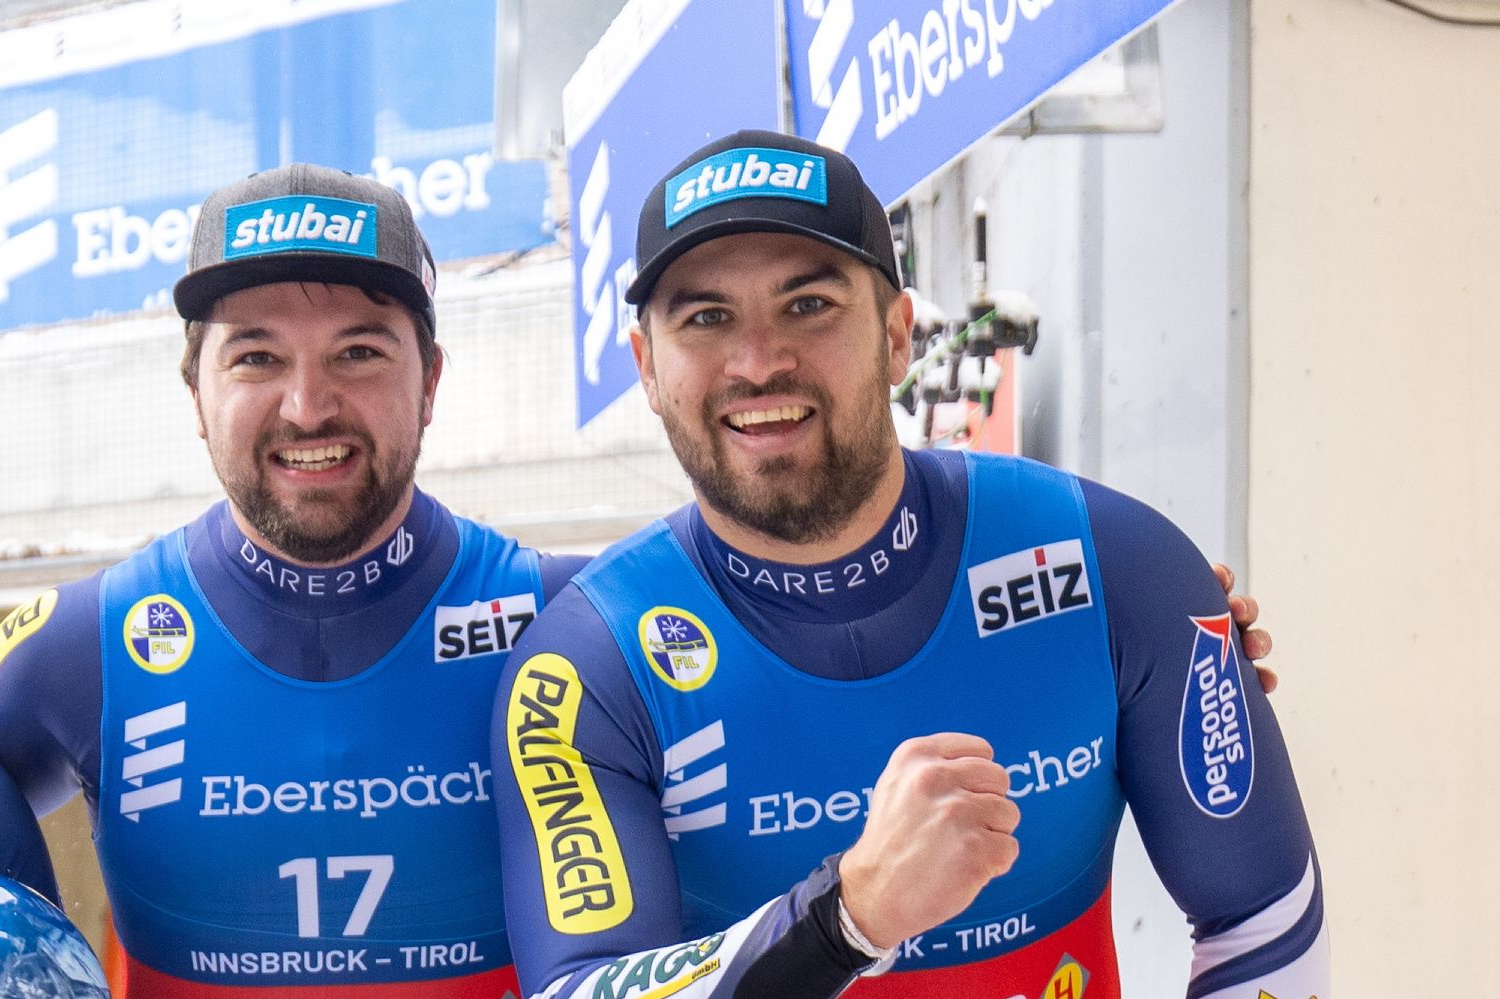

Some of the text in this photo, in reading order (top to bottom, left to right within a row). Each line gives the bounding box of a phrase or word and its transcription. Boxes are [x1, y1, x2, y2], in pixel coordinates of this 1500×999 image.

[673, 154, 815, 214] stubai
[232, 202, 368, 249] stubai
[151, 641, 176, 655] FIL
[673, 655, 700, 670] FIL
[1194, 654, 1238, 807] personal
[1218, 678, 1245, 765] shop
[199, 761, 492, 818] Eberspäch
[516, 669, 616, 920] PALFINGER
[277, 855, 395, 938] 17
[190, 949, 368, 975] INNSBRUCK
[399, 940, 485, 970] TIROL
[955, 911, 1036, 952] TIROL
